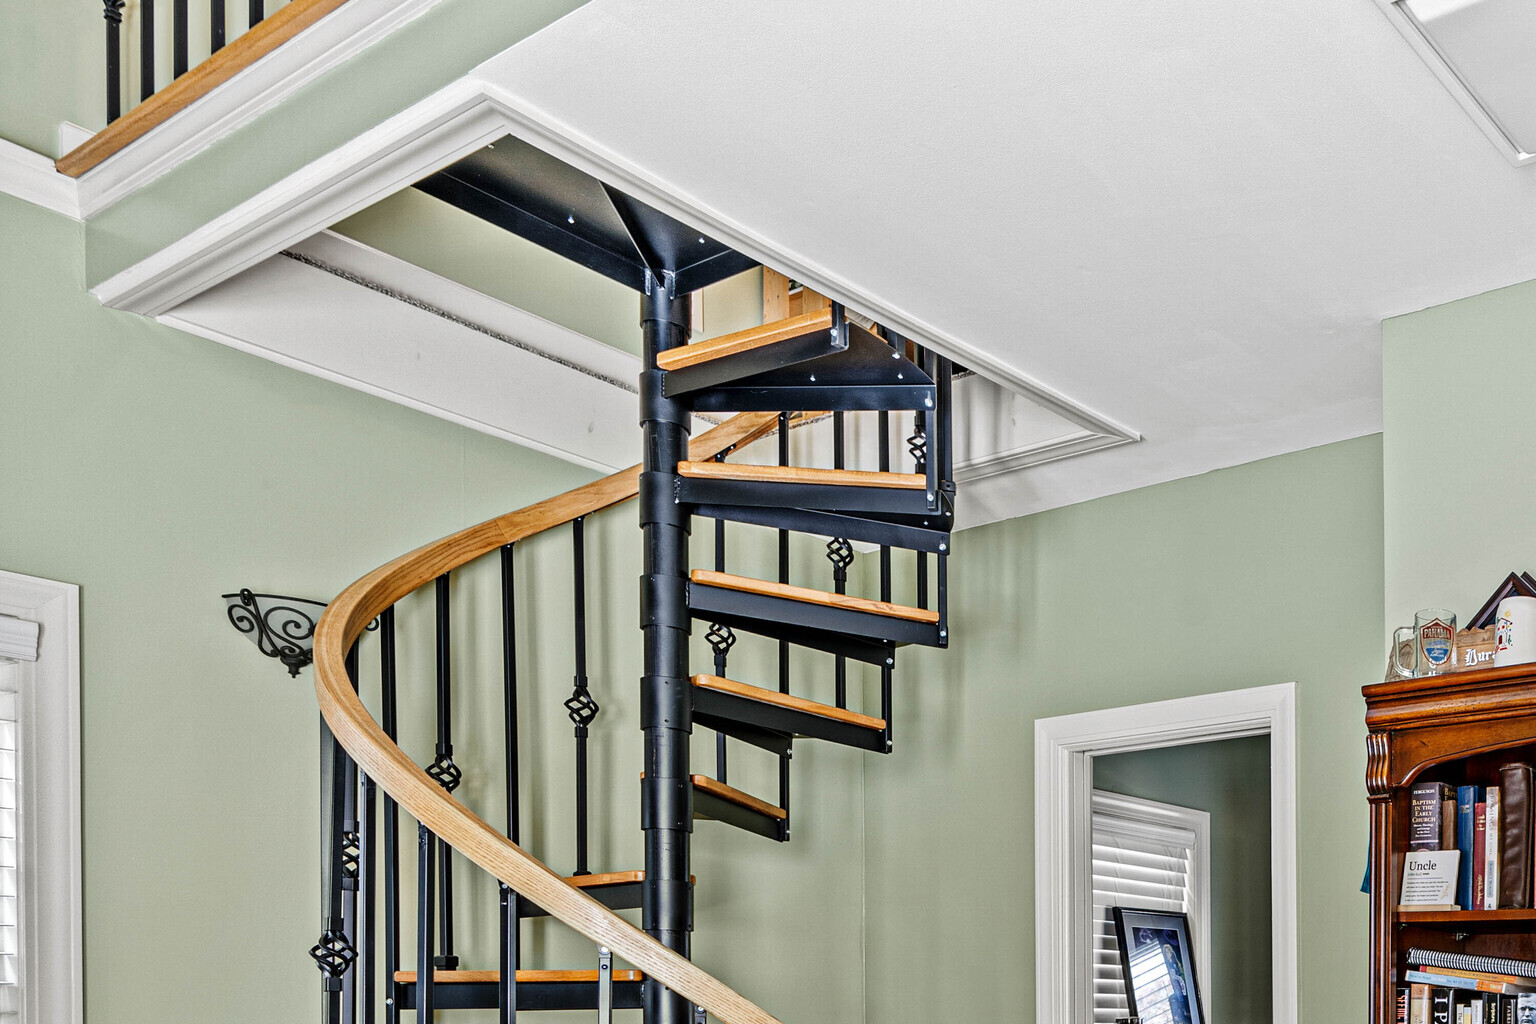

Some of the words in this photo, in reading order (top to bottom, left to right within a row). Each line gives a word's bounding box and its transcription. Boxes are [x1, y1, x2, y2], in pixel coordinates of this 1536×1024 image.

[1423, 628, 1451, 639] PANAMA
[1409, 860, 1436, 871] Uncle
[1435, 996, 1448, 1004] I
